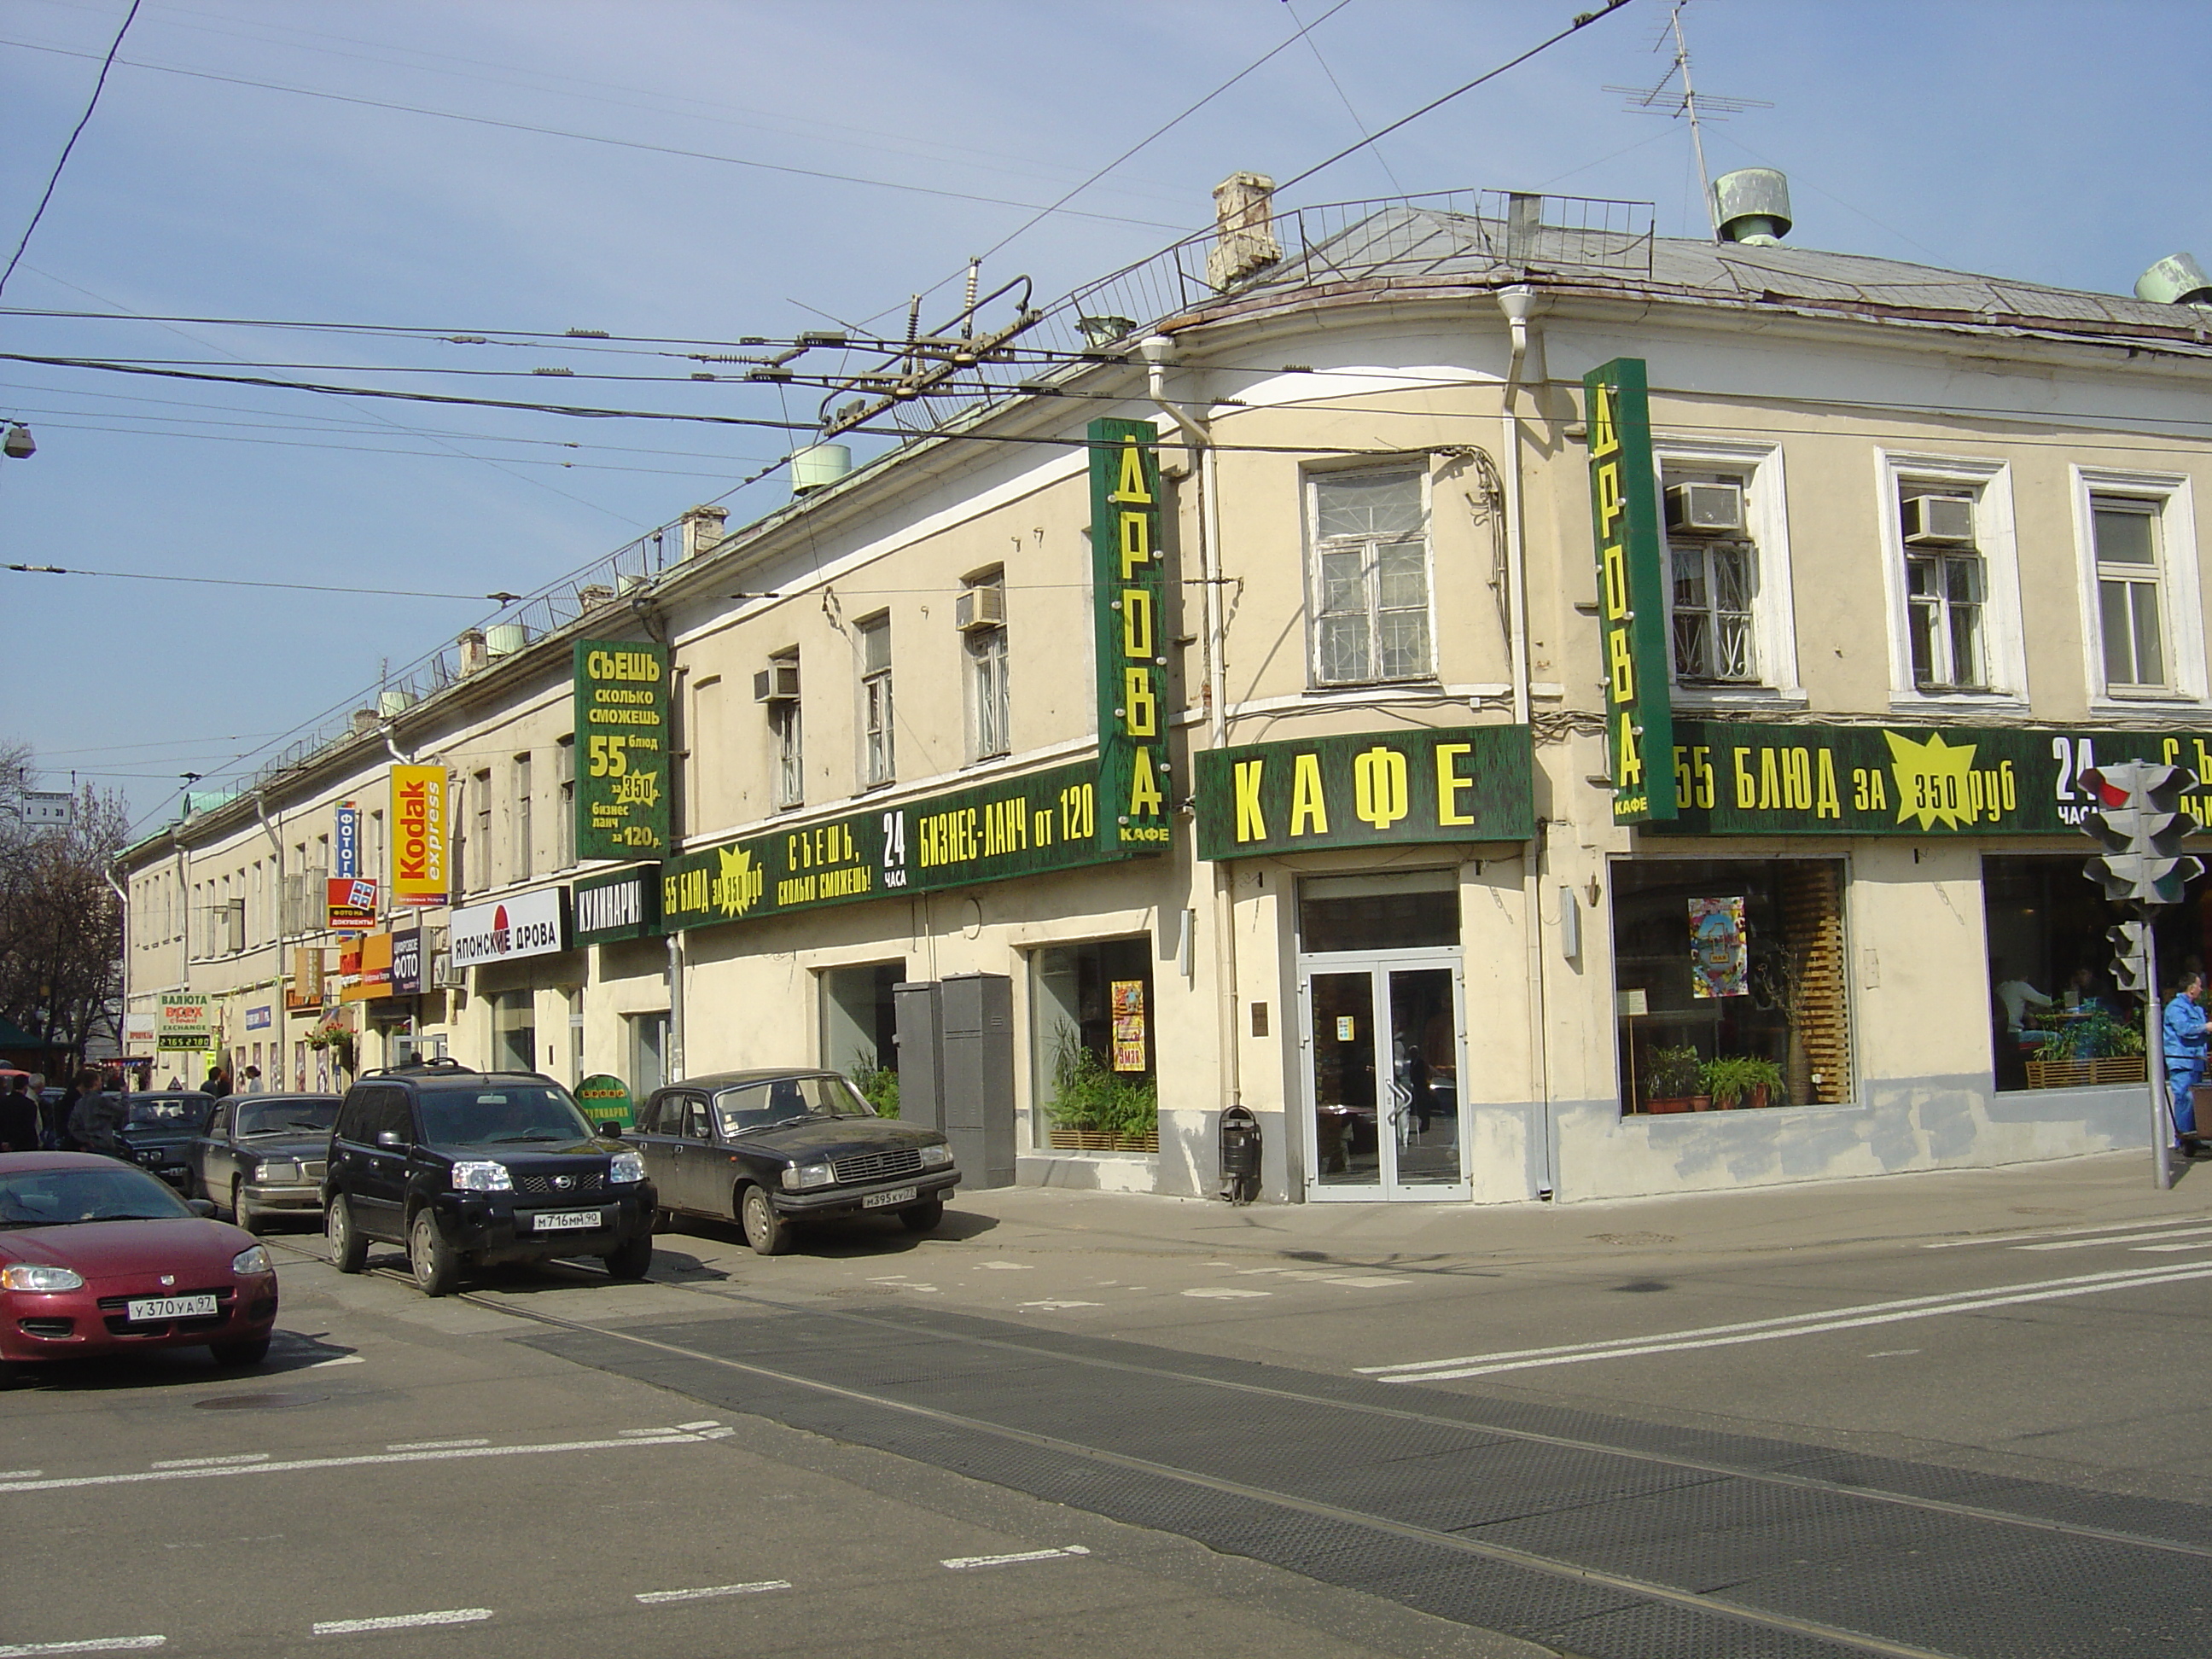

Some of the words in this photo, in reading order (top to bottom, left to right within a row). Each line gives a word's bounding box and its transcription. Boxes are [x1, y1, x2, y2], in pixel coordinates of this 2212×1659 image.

[1593, 382, 1641, 786] ДРОВА
[1115, 435, 1161, 815] ДРОВА
[588, 650, 660, 681] СЪЕШЬ
[589, 708, 661, 725] СМОЖЕШЬ
[590, 735, 626, 777] 55
[628, 735, 658, 751] блюд
[611, 784, 621, 793] за
[625, 777, 650, 798] 350
[1234, 743, 1476, 843] КАФЕ
[1674, 746, 1714, 809] 55
[1734, 747, 1841, 819] БЛЮД
[1853, 768, 1887, 811] ЗА
[1914, 774, 1958, 809] 350
[1969, 760, 2016, 823] руб
[592, 801, 629, 815] бизнес
[1615, 796, 1647, 815] КАФЕ
[2058, 806, 2099, 825] ЧАС
[399, 779, 426, 881] Kodak
[428, 781, 441, 882] express
[592, 817, 619, 828] ланч
[612, 833, 622, 842] за
[624, 826, 652, 846] 120
[919, 796, 1027, 868] БИЗНЕС-ЛАНЧ
[1060, 783, 1094, 841] 120
[1120, 827, 1170, 841] КАФЕ
[789, 823, 859, 871] СЪЕШЬ,
[883, 811, 905, 868] 24
[665, 876, 677, 915] 55
[680, 868, 709, 913] БЛЮД
[726, 875, 742, 903] 350
[747, 861, 762, 906] руб
[778, 875, 816, 906] СКОЛЬКО
[820, 864, 871, 899] СМОЖЕШЬ!
[884, 870, 907, 888] ЧАСА
[579, 880, 643, 933] КУЛИНАРИЯ
[456, 928, 512, 960] ЯПОНСКИЕ
[516, 921, 556, 951] ДРОВА
[394, 953, 418, 979] ФОТО
[162, 995, 207, 1004] ВАЛЮТА
[166, 1007, 203, 1017] ВСЕХ
[585, 1213, 597, 1222] 90
[197, 1296, 211, 1308] 97
